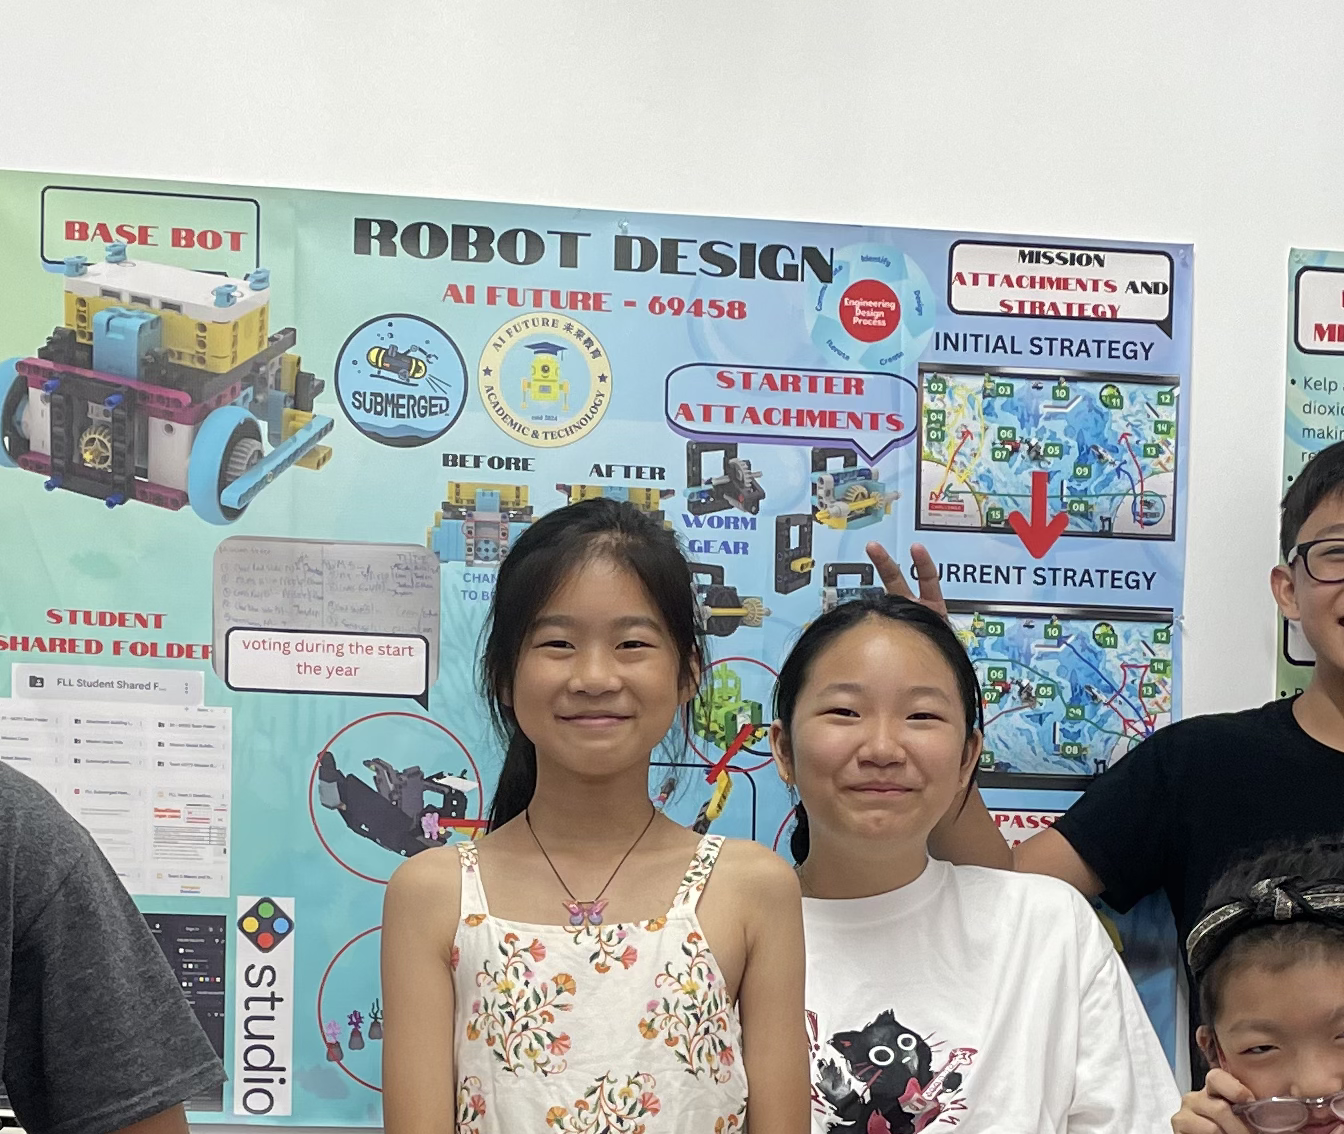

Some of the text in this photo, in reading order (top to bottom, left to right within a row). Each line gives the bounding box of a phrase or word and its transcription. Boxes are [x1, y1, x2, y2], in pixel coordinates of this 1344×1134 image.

[64, 220, 248, 252] BASE BOT
[354, 216, 834, 284] ROBOT DESIGN
[1018, 249, 1106, 269] MISSION
[952, 272, 1169, 296] ATTACHMENTS AND
[443, 282, 747, 321] AI FUTURE 69458
[844, 297, 896, 311] Engineering
[999, 299, 1121, 319] STRATEGY
[506, 316, 559, 340] FUTURE
[853, 316, 886, 327] Process
[934, 331, 1155, 361] INITIAL STRATEGY
[716, 370, 865, 396] STARTER
[1303, 377, 1338, 393] Kelp
[351, 391, 450, 419] SUBMERGED
[484, 384, 606, 441] ACADEMIC TECHNOLOGY
[675, 402, 905, 432] ATTACHMENTS
[442, 452, 536, 473] BEFORE
[588, 463, 666, 480] AFTER
[682, 514, 756, 531] WORM
[688, 539, 749, 556] GEAR
[1032, 566, 1156, 590] STRATEGY
[461, 591, 480, 601] TO
[45, 608, 167, 631] STUDENT
[242, 639, 414, 658] voting during the start
[296, 662, 360, 679] the year
[57, 678, 151, 690] FLL Student Shared
[242, 963, 287, 1116] studio
